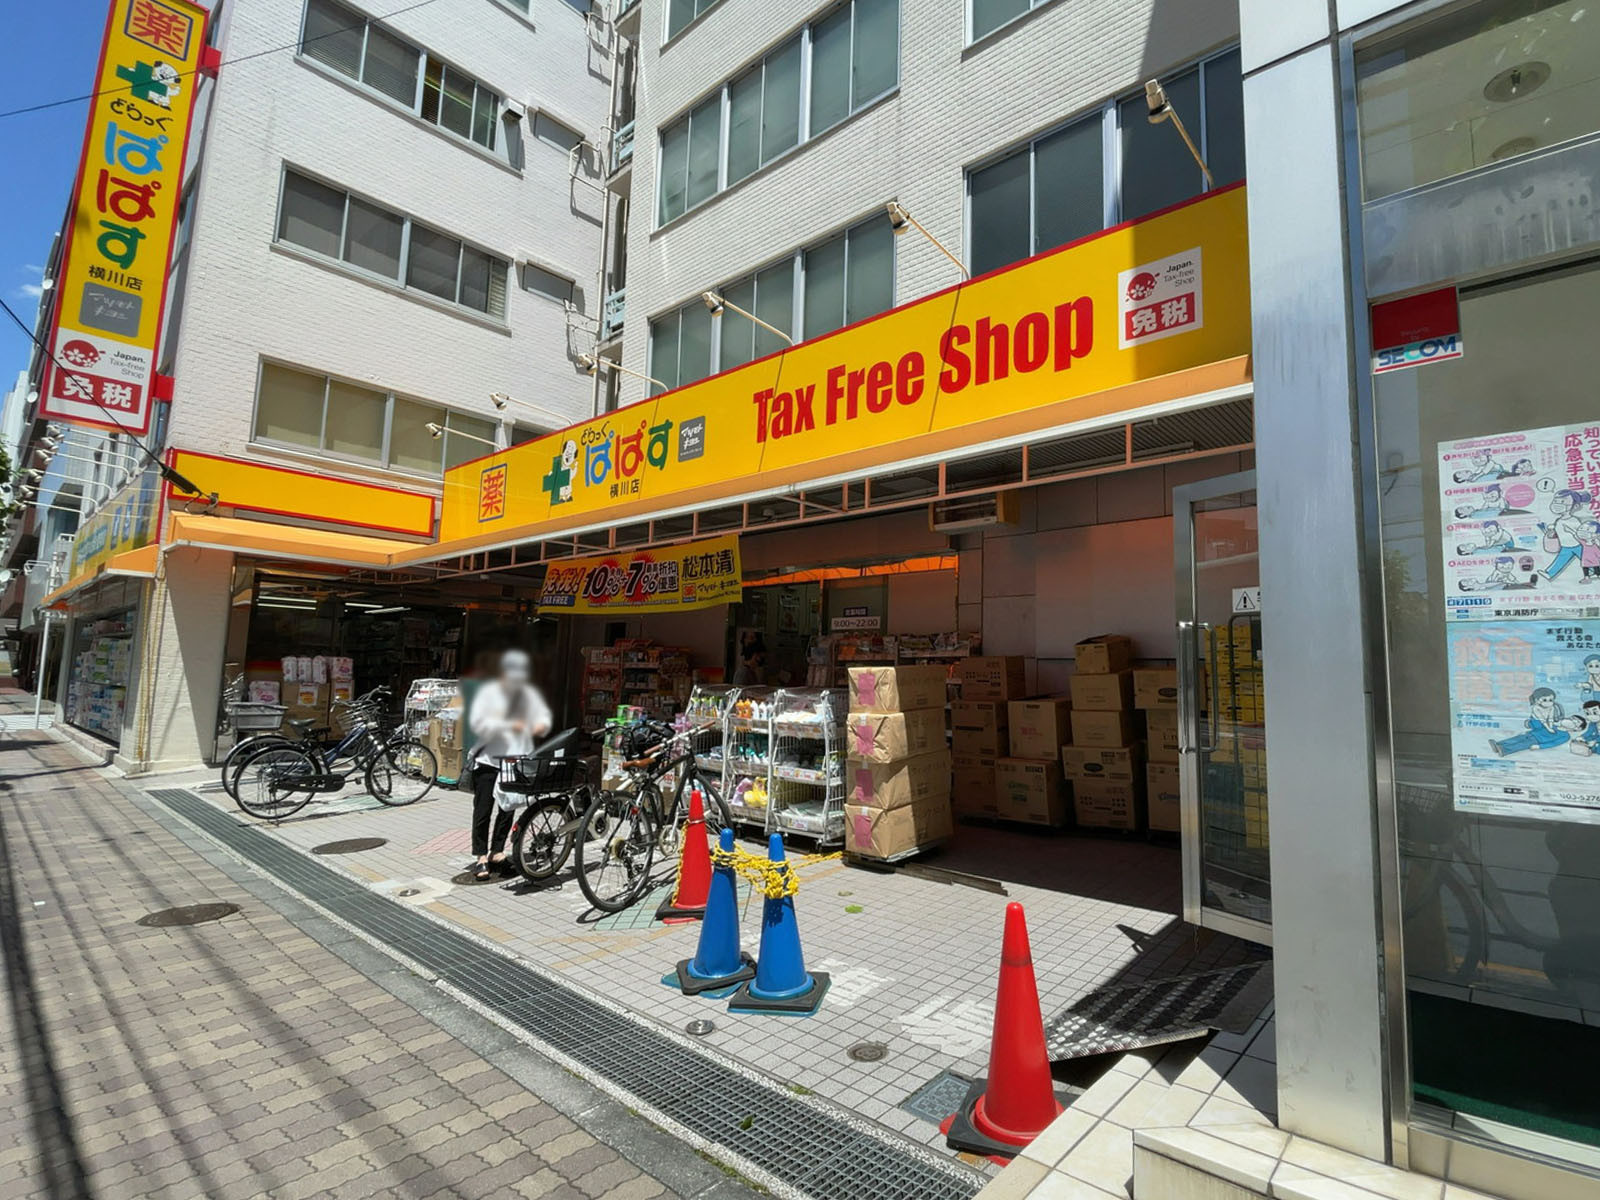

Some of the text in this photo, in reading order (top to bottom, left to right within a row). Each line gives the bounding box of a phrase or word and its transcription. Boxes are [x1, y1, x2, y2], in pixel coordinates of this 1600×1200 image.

[132, 0, 187, 54] 薬
[96, 121, 168, 269] ぱぱす
[88, 264, 143, 291] 横川店
[1164, 268, 1195, 282] Tax-free
[1175, 277, 1195, 287] Shop
[1132, 297, 1188, 337] 免税
[109, 357, 145, 372] Tax-free
[1378, 336, 1456, 366] SECOM
[121, 368, 144, 380] Shop
[753, 295, 1094, 443] Tax Free Shop
[62, 374, 133, 408] 免税
[584, 419, 673, 487] ぱぱす
[1564, 434, 1585, 491] 応急手当
[482, 471, 505, 517] 薬
[610, 478, 640, 498] 横川店
[683, 549, 735, 580] 松本清
[1494, 608, 1539, 617] 東京消防庁
